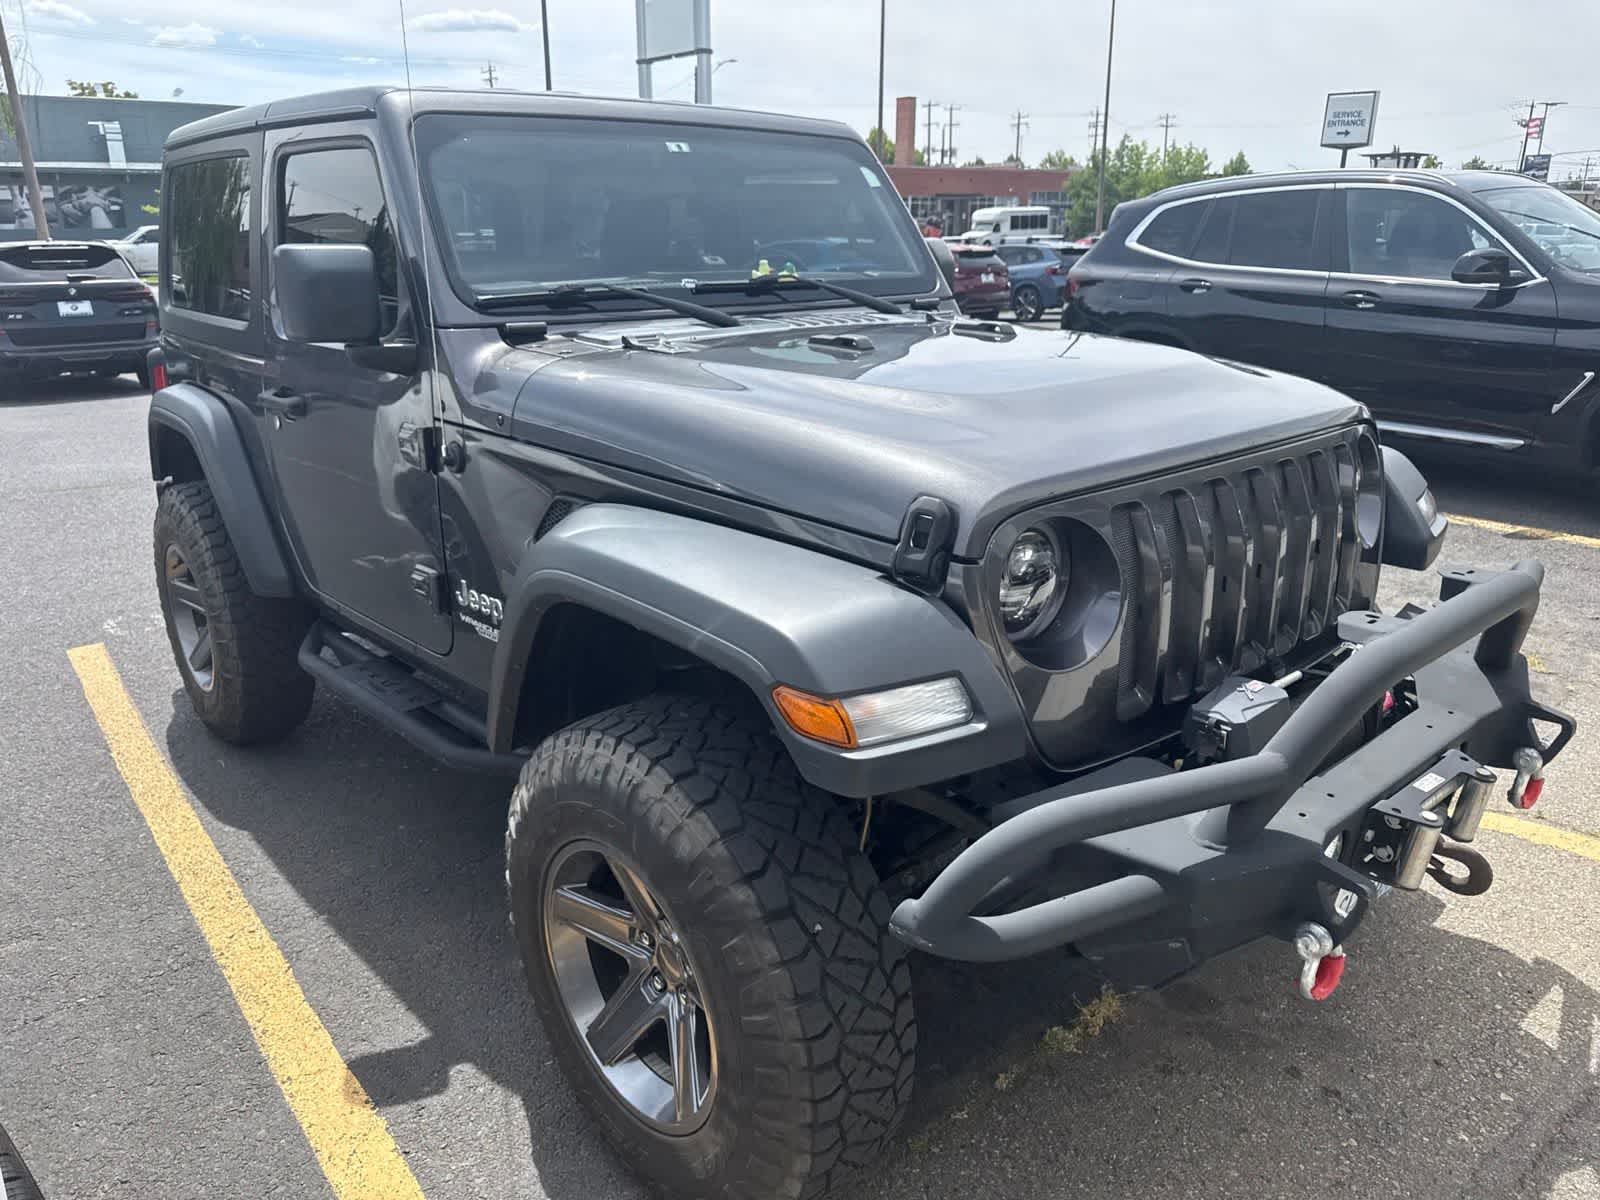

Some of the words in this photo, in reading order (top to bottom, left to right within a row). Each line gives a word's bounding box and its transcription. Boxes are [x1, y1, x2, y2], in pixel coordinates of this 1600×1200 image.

[1332, 110, 1363, 118] SERVICE
[1327, 118, 1366, 128] ENTRANCE
[455, 578, 503, 625] Jeep
